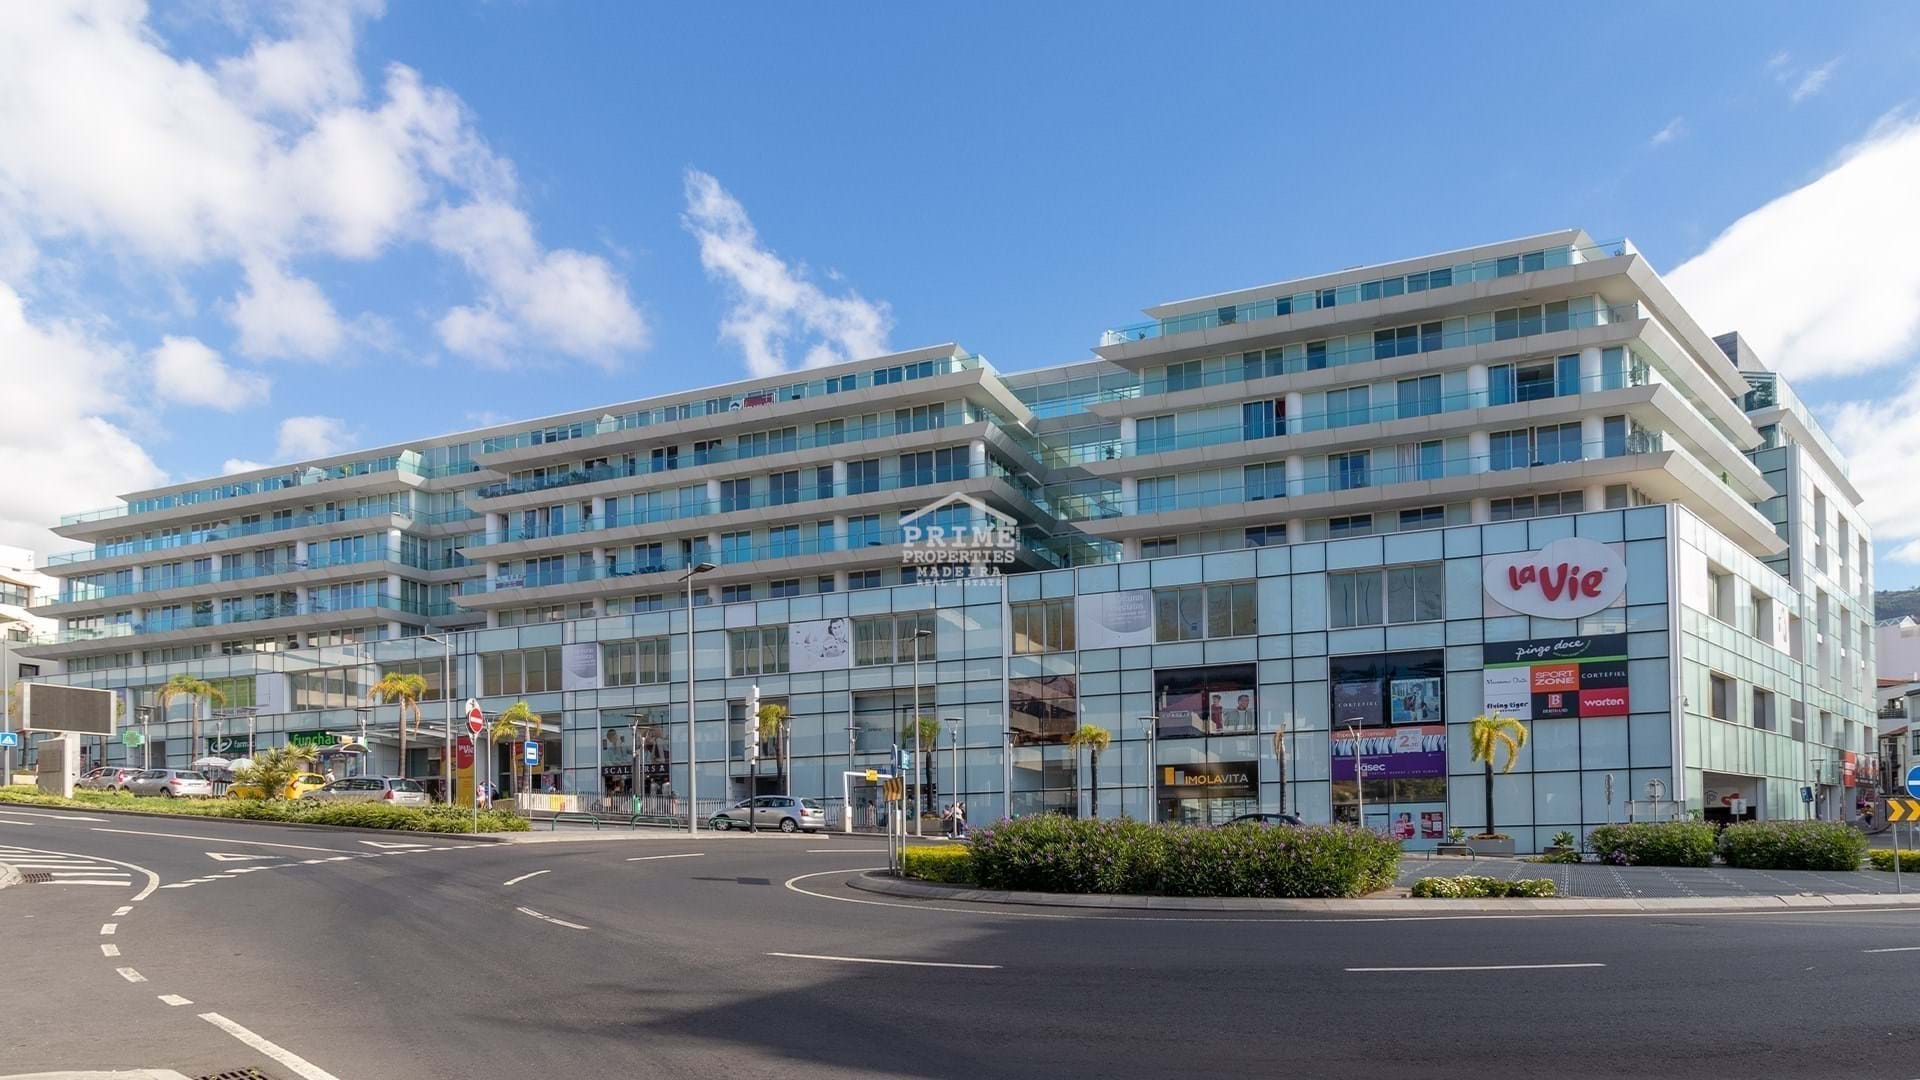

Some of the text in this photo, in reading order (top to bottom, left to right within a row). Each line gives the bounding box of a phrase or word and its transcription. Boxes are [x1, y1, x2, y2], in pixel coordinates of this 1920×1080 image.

[1516, 639, 1584, 660] pingo doce
[1535, 669, 1574, 678] SPORT
[1581, 671, 1626, 679] CORTEFIEL
[1535, 677, 1575, 685] ZONE
[1509, 701, 1528, 709] tiger
[1583, 698, 1624, 707] worten
[1185, 773, 1249, 785] IMOLAVITA
